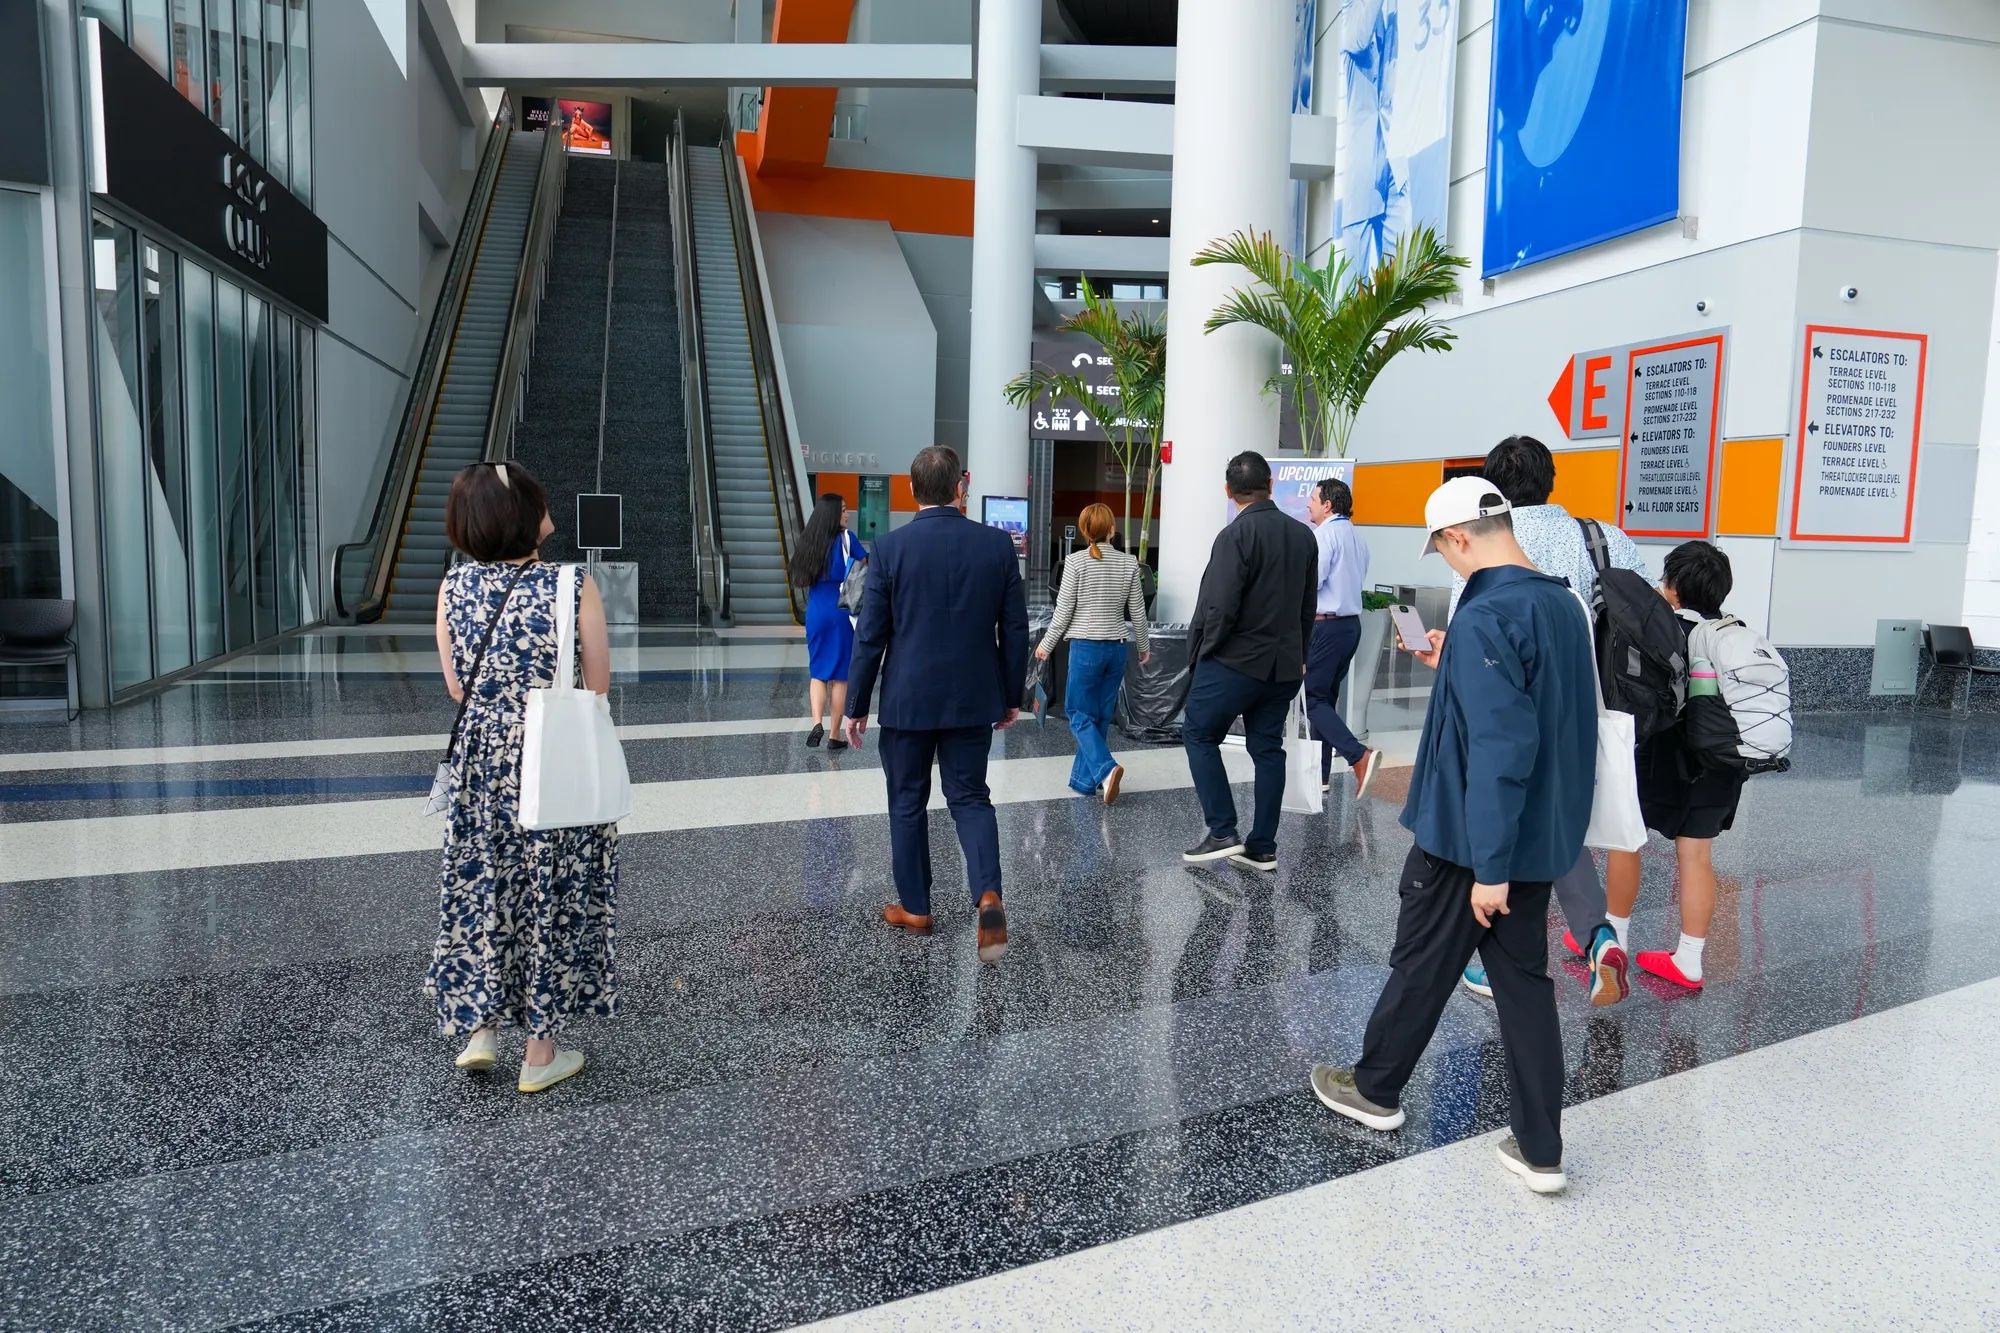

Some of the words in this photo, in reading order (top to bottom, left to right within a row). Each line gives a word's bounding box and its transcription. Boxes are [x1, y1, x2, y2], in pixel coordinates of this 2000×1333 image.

[1830, 348, 1890, 365] ESCALATORS
[1893, 353, 1908, 366] TO:
[1646, 359, 1692, 377] ESCALATORS
[1694, 358, 1707, 370] TO:
[1829, 366, 1863, 378] TERRACE
[1865, 369, 1887, 380] LEVEL
[1645, 379, 1671, 391] TERRACE
[1672, 377, 1690, 388] LEVEL
[1828, 378, 1865, 390] SECTIONS
[1868, 381, 1896, 393] 110-118
[1581, 355, 1612, 430] E
[1644, 390, 1673, 401] SECTIONS
[1674, 386, 1698, 398] 110-118
[1643, 402, 1679, 415] PROMENADE
[1680, 401, 1698, 411] LEVEL
[1826, 394, 1873, 406] PROMENADE
[1875, 397, 1897, 408] LEVEL
[1643, 414, 1671, 426] SECTIONS
[1672, 412, 1697, 423] 217-232
[1826, 406, 1863, 417] SECTIONS
[1865, 408, 1896, 420] 217-232
[1642, 429, 1681, 442] ELEVATORS
[1683, 427, 1696, 439] TO:
[1825, 423, 1876, 437] ELEVATORS
[1879, 426, 1894, 439] TO:
[1641, 446, 1670, 456] FOUNDERS
[1671, 444, 1689, 454] LEVEL
[1823, 440, 1862, 452] FOUNDERS
[1864, 443, 1887, 453] LEVEL
[811, 450, 880, 468] ICKETS
[1640, 460, 1665, 469] TERRACE
[1666, 459, 1684, 469] LEVEL
[1822, 456, 1856, 467] TERRACE
[1857, 458, 1880, 468] LEVEL
[1278, 466, 1344, 482] UPCOMING
[1639, 473, 1674, 482] THREATLOCKER
[1674, 472, 1686, 481] CLUB
[1686, 471, 1701, 481] LEVEL
[1821, 471, 1867, 482] THREATLOCKER
[1868, 473, 1882, 483] CLUB
[1883, 473, 1901, 484] LEVEL
[1638, 486, 1673, 495] PROMENADE
[1674, 486, 1692, 495] LEVEL
[1819, 485, 1865, 497] PROMENADE
[1867, 487, 1889, 497] LEVEL
[1637, 501, 1650, 512] ALL
[1651, 501, 1674, 512] FLOOR
[1675, 501, 1699, 512] SEATS
